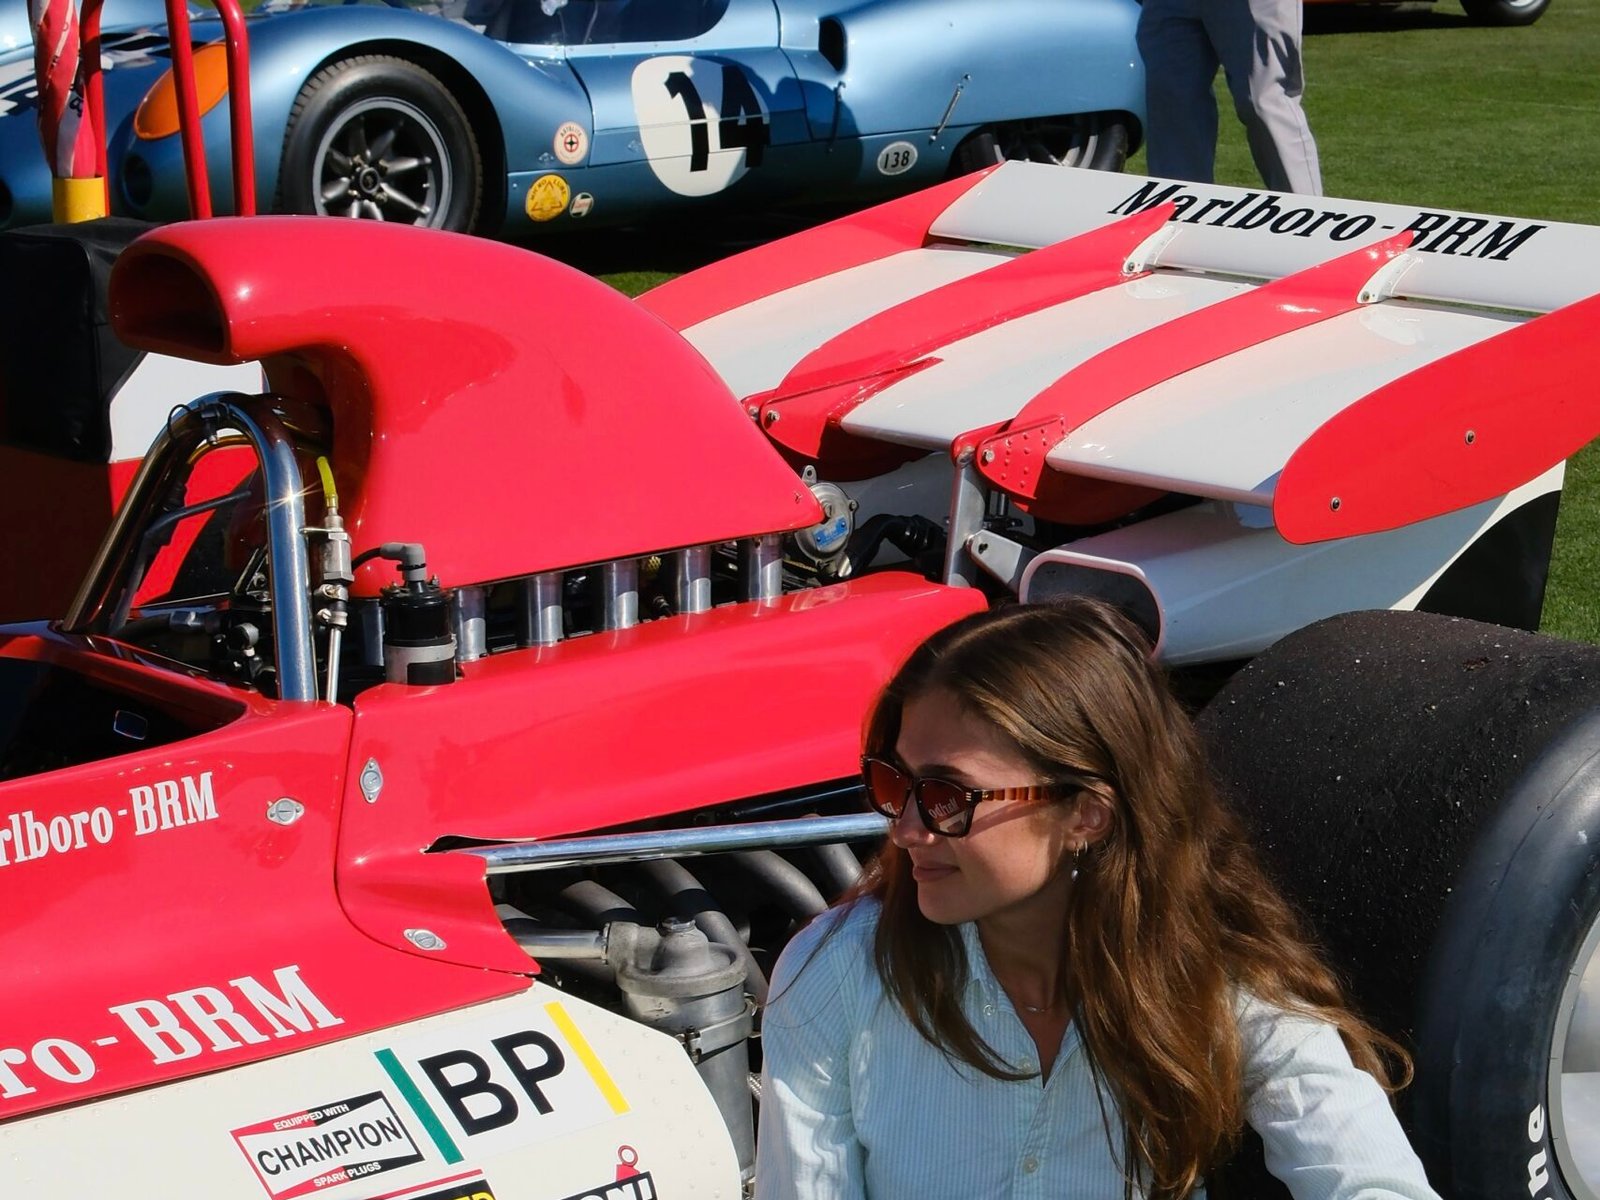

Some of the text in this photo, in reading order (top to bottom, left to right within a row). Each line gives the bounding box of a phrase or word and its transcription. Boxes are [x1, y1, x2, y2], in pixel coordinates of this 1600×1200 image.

[664, 64, 771, 172] 14
[883, 150, 910, 169] 138
[418, 1030, 566, 1137] BP
[273, 1103, 350, 1131] EQUIPPED WITH
[257, 1116, 403, 1176] CHAMPION
[313, 1161, 382, 1188] SPARK PLUGS
